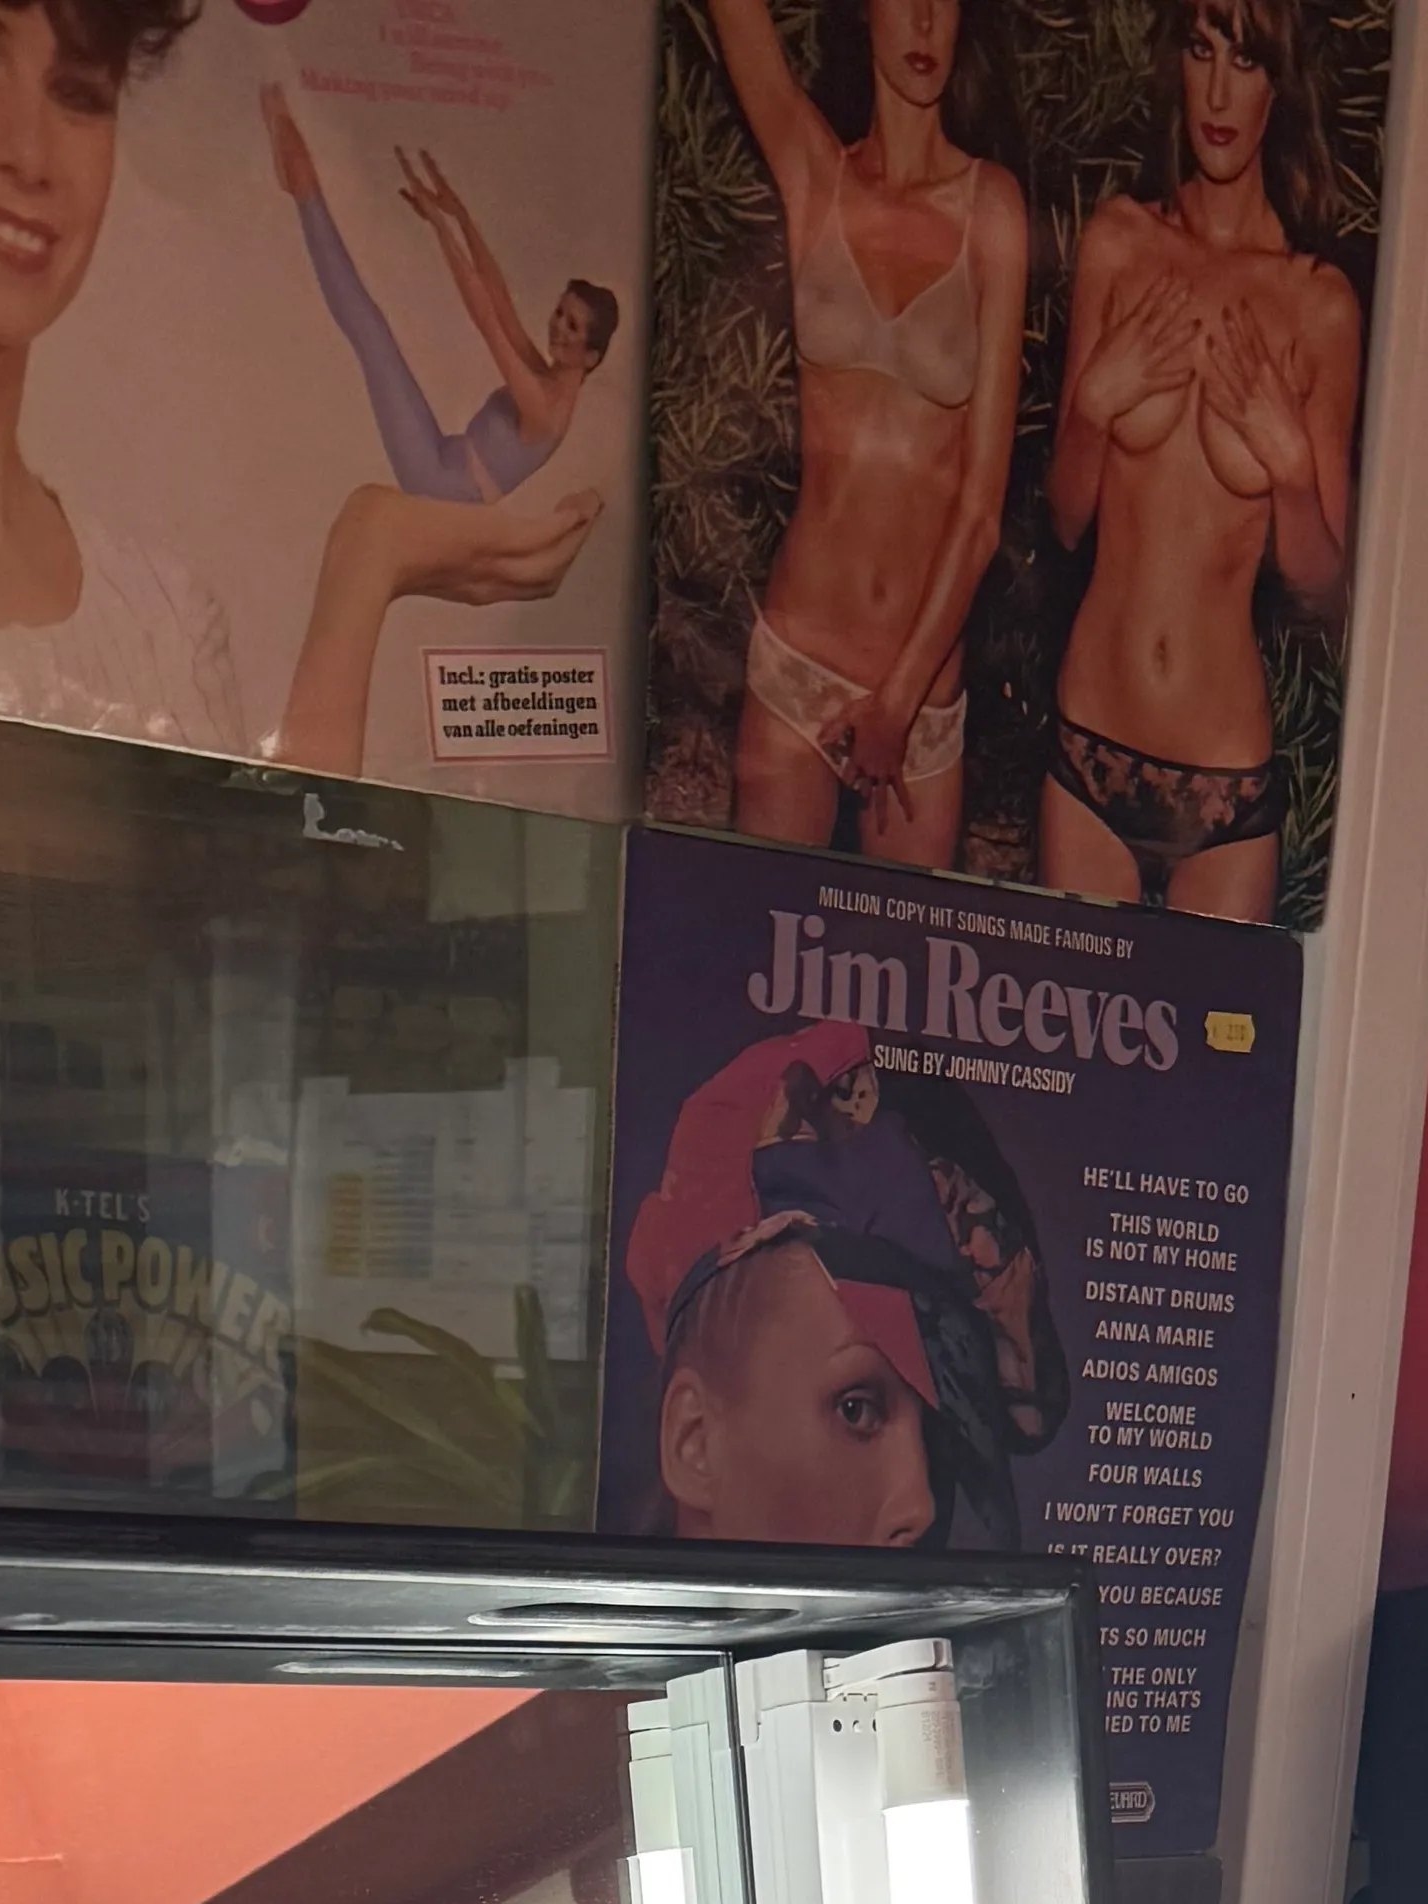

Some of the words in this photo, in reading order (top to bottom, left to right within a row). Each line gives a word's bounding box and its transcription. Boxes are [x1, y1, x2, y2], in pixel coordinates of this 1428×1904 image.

[489, 666, 539, 688] gratis
[542, 668, 595, 688] poster
[442, 696, 476, 712] met
[482, 691, 597, 713] afbeeldingen
[443, 724, 473, 739] van
[475, 719, 506, 738] alle
[508, 718, 599, 739] oefeningen
[819, 885, 881, 917] MILLION
[886, 897, 926, 925] COPY
[929, 905, 954, 929] HIT
[957, 909, 1006, 938] SONGS
[1010, 919, 1051, 946] MADE
[1055, 926, 1112, 957] FAMOUS
[1116, 936, 1135, 960] BY
[746, 908, 908, 1033] Jim
[921, 935, 1180, 1072] Reeves
[873, 1043, 919, 1073] SUNG
[922, 1052, 945, 1076] BY
[945, 1054, 1010, 1088] JOHNNY
[1011, 1062, 1077, 1096] CASSIDY
[1083, 1166, 1135, 1192] HE'LL
[1140, 1174, 1190, 1198] HAVE
[1196, 1180, 1219, 1200] TO
[1224, 1185, 1250, 1205] GO
[1110, 1211, 1152, 1235] THIS
[1156, 1217, 1220, 1243] WORLD
[1085, 1237, 1104, 1258] IS
[1110, 1240, 1148, 1261] NOT
[1152, 1244, 1181, 1265] MY
[1185, 1248, 1238, 1272] HOME
[99, 1228, 294, 1372] POWER
[1085, 1280, 1166, 1306] DISTANT
[1170, 1288, 1236, 1314] DRUMS
[1095, 1320, 1151, 1344] ANNA
[1156, 1325, 1215, 1349] MARIE
[1082, 1358, 1140, 1382] ADIOS
[1144, 1363, 1219, 1388] AMIGOS
[1105, 1401, 1197, 1426] WELCOME
[1087, 1424, 1112, 1445] TO
[1117, 1427, 1145, 1447] MY
[1149, 1429, 1213, 1451] WORLD
[1088, 1464, 1137, 1485] FOUR
[1143, 1466, 1204, 1489] WALLS
[1044, 1501, 1052, 1521] I
[1056, 1502, 1118, 1524] WON'T
[1122, 1504, 1193, 1527] FORGET
[1198, 1508, 1235, 1528] YOU
[1093, 1544, 1159, 1566] REALLY
[1165, 1548, 1222, 1568] OVER?
[1098, 1585, 1135, 1605] YOU
[1140, 1586, 1223, 1606] BECAUSE
[1124, 1628, 1148, 1647] SO
[1153, 1628, 1207, 1648] MUCH
[1112, 1667, 1146, 1686] THE
[1151, 1667, 1198, 1687] ONLY
[1106, 1690, 1139, 1710] ING
[1143, 1690, 1202, 1709] THAT'S
[1139, 1715, 1162, 1733] TO
[1166, 1714, 1192, 1733] ME
